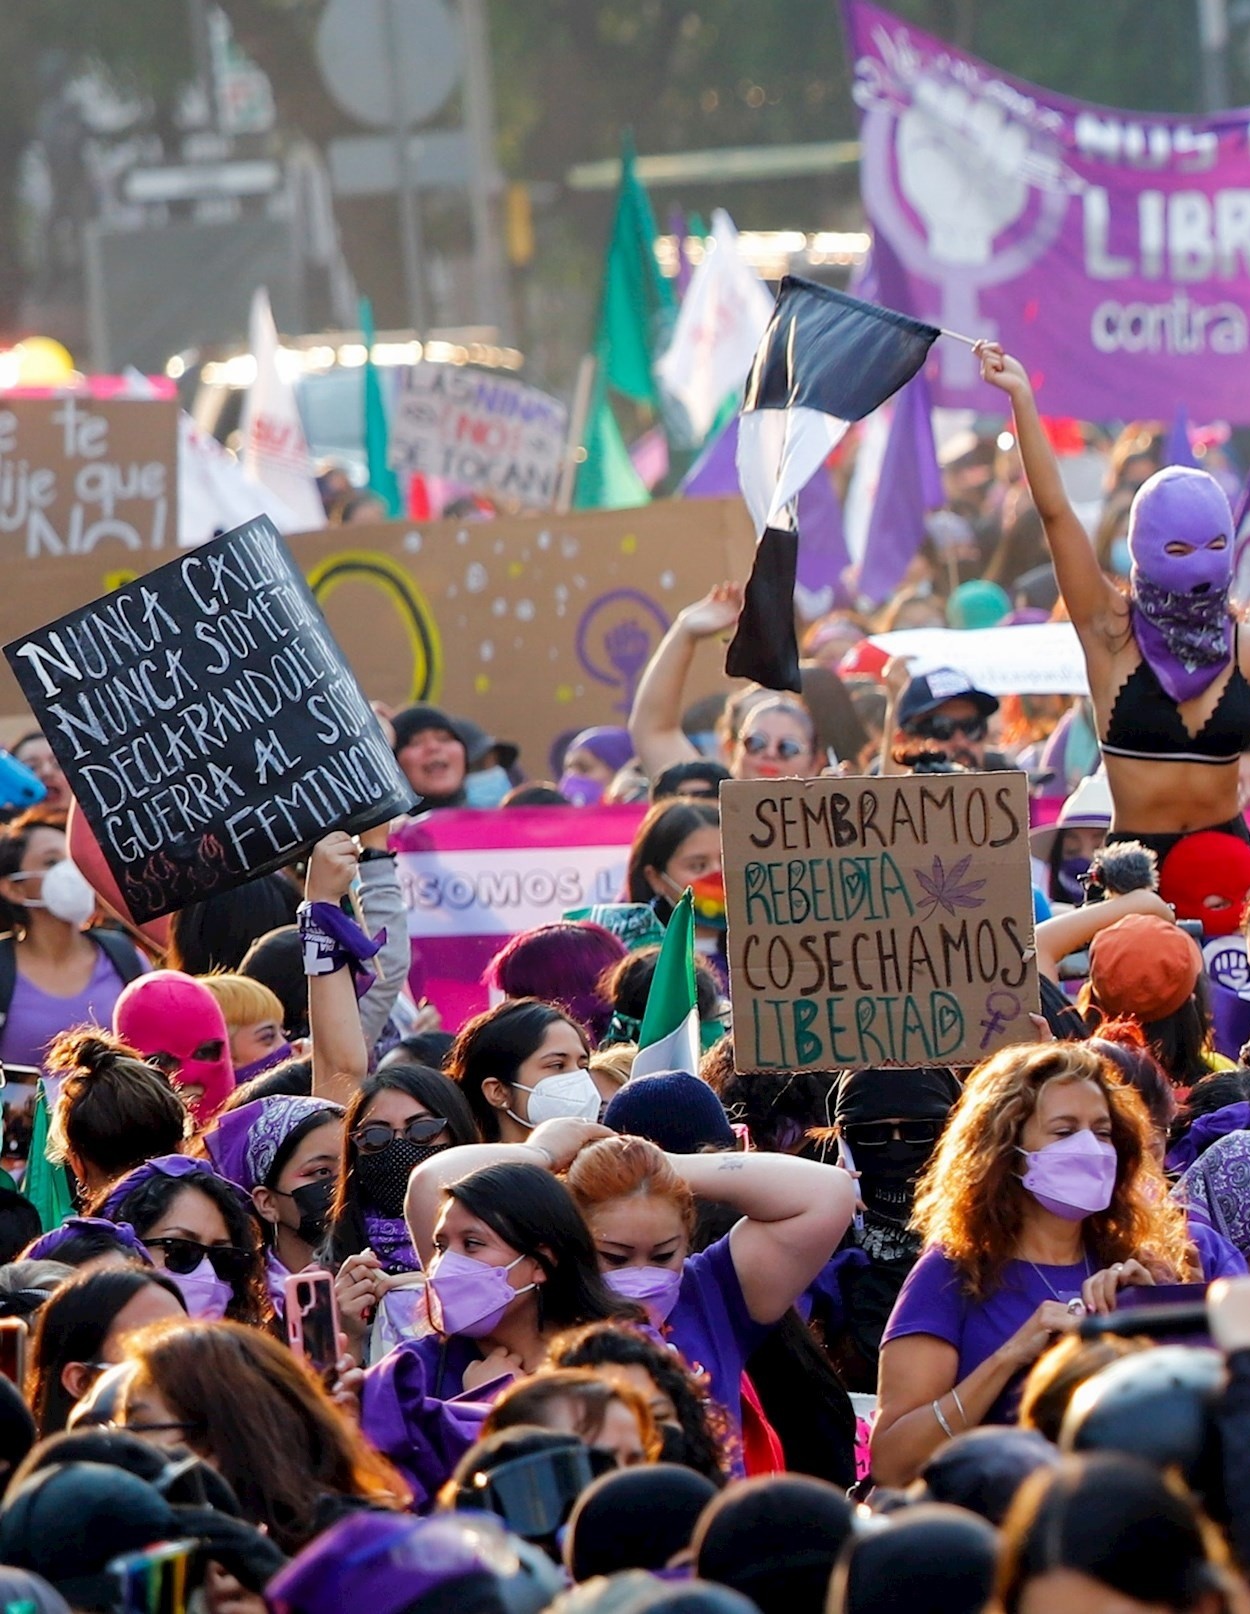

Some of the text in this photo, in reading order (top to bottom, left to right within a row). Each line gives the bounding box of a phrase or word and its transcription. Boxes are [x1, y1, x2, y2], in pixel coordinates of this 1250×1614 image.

[1090, 290, 1249, 355] contra
[52, 397, 109, 458] te
[0, 459, 166, 532] ije que
[17, 585, 181, 699] NUNCA
[46, 647, 199, 762] NUNCA
[104, 760, 246, 865] GUERRA
[254, 728, 303, 786] AL
[750, 785, 1021, 850] SEMBRAMOS
[745, 851, 916, 925] REBELDIA
[743, 916, 1029, 996] COSECHAMOS
[752, 991, 965, 1069] LIBERTAD
